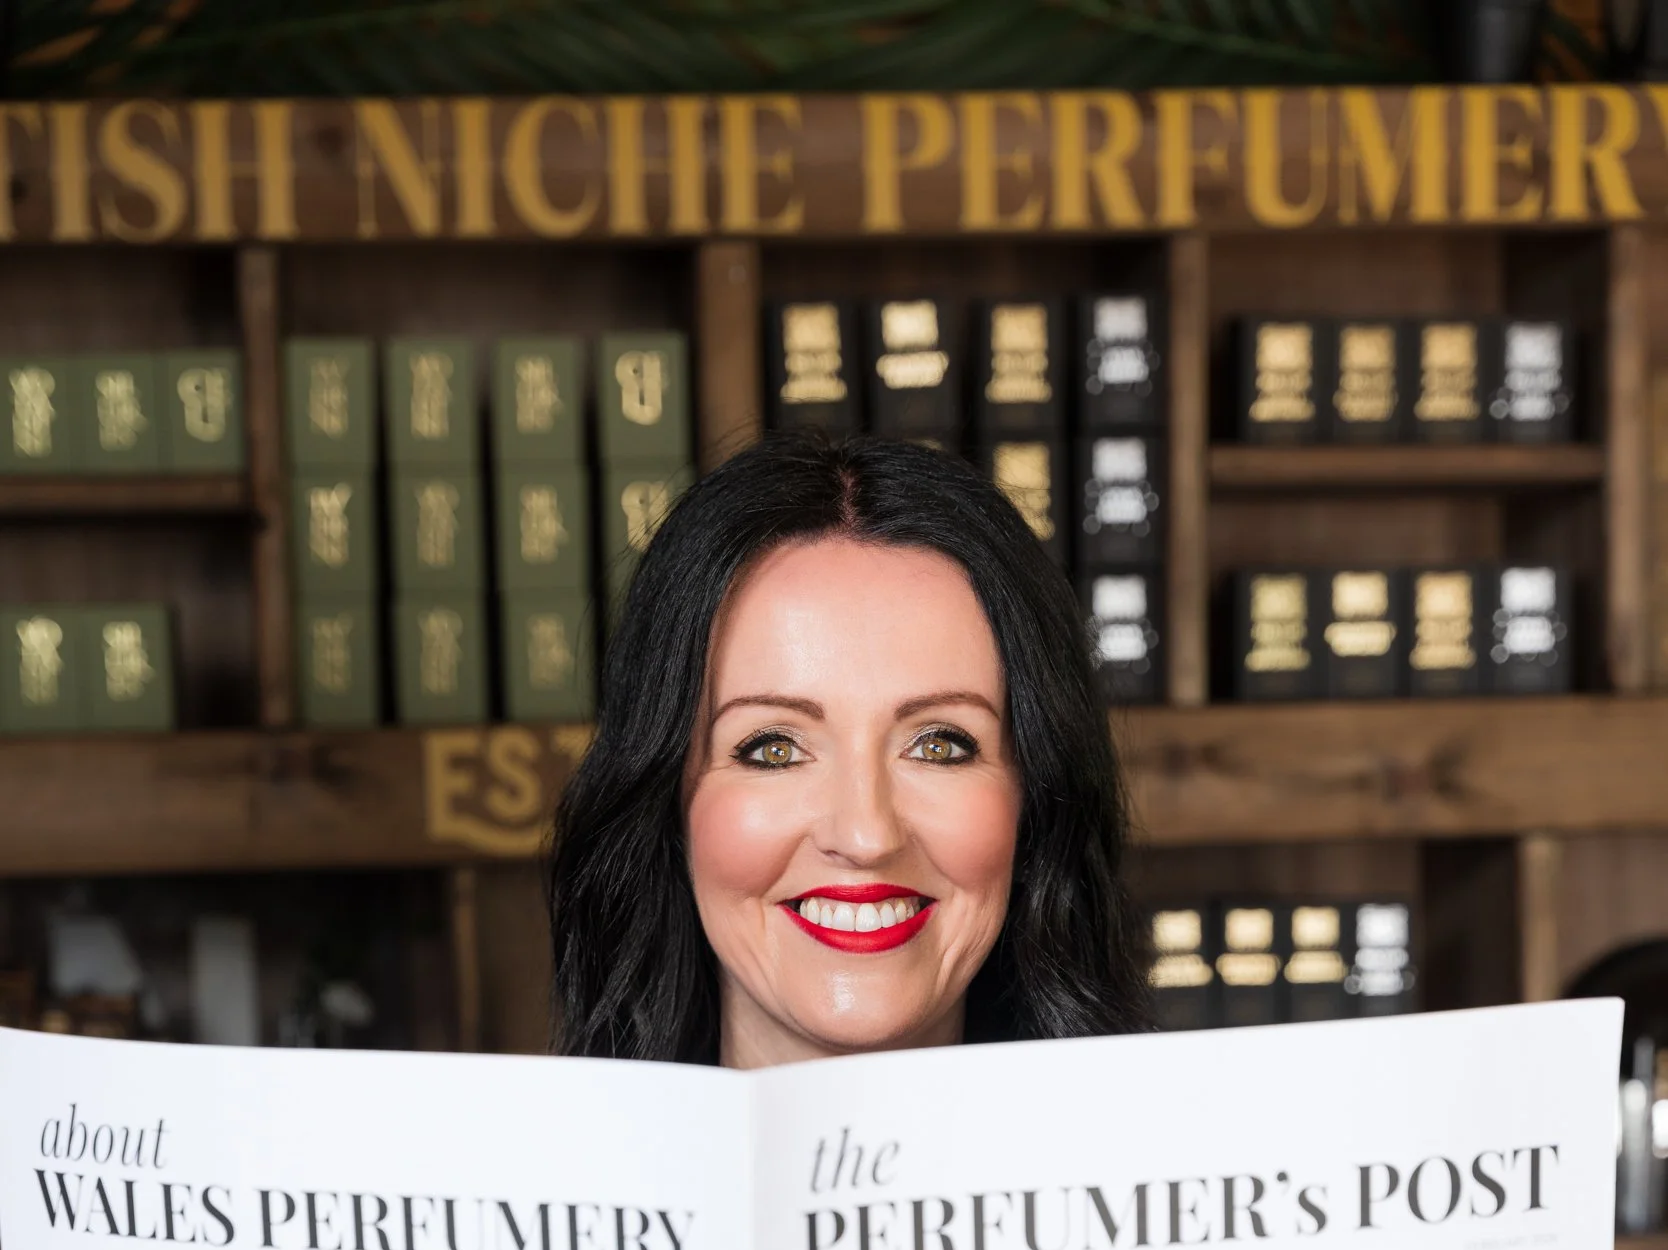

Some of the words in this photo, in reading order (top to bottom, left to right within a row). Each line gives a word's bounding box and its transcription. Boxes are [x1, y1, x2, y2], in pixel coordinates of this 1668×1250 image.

[353, 95, 806, 239] NICHE
[858, 84, 1668, 231] PERFUMER
[39, 1101, 171, 1170] about
[808, 1123, 903, 1196] the
[34, 1168, 236, 1248] WALES
[1354, 1142, 1561, 1232] POST
